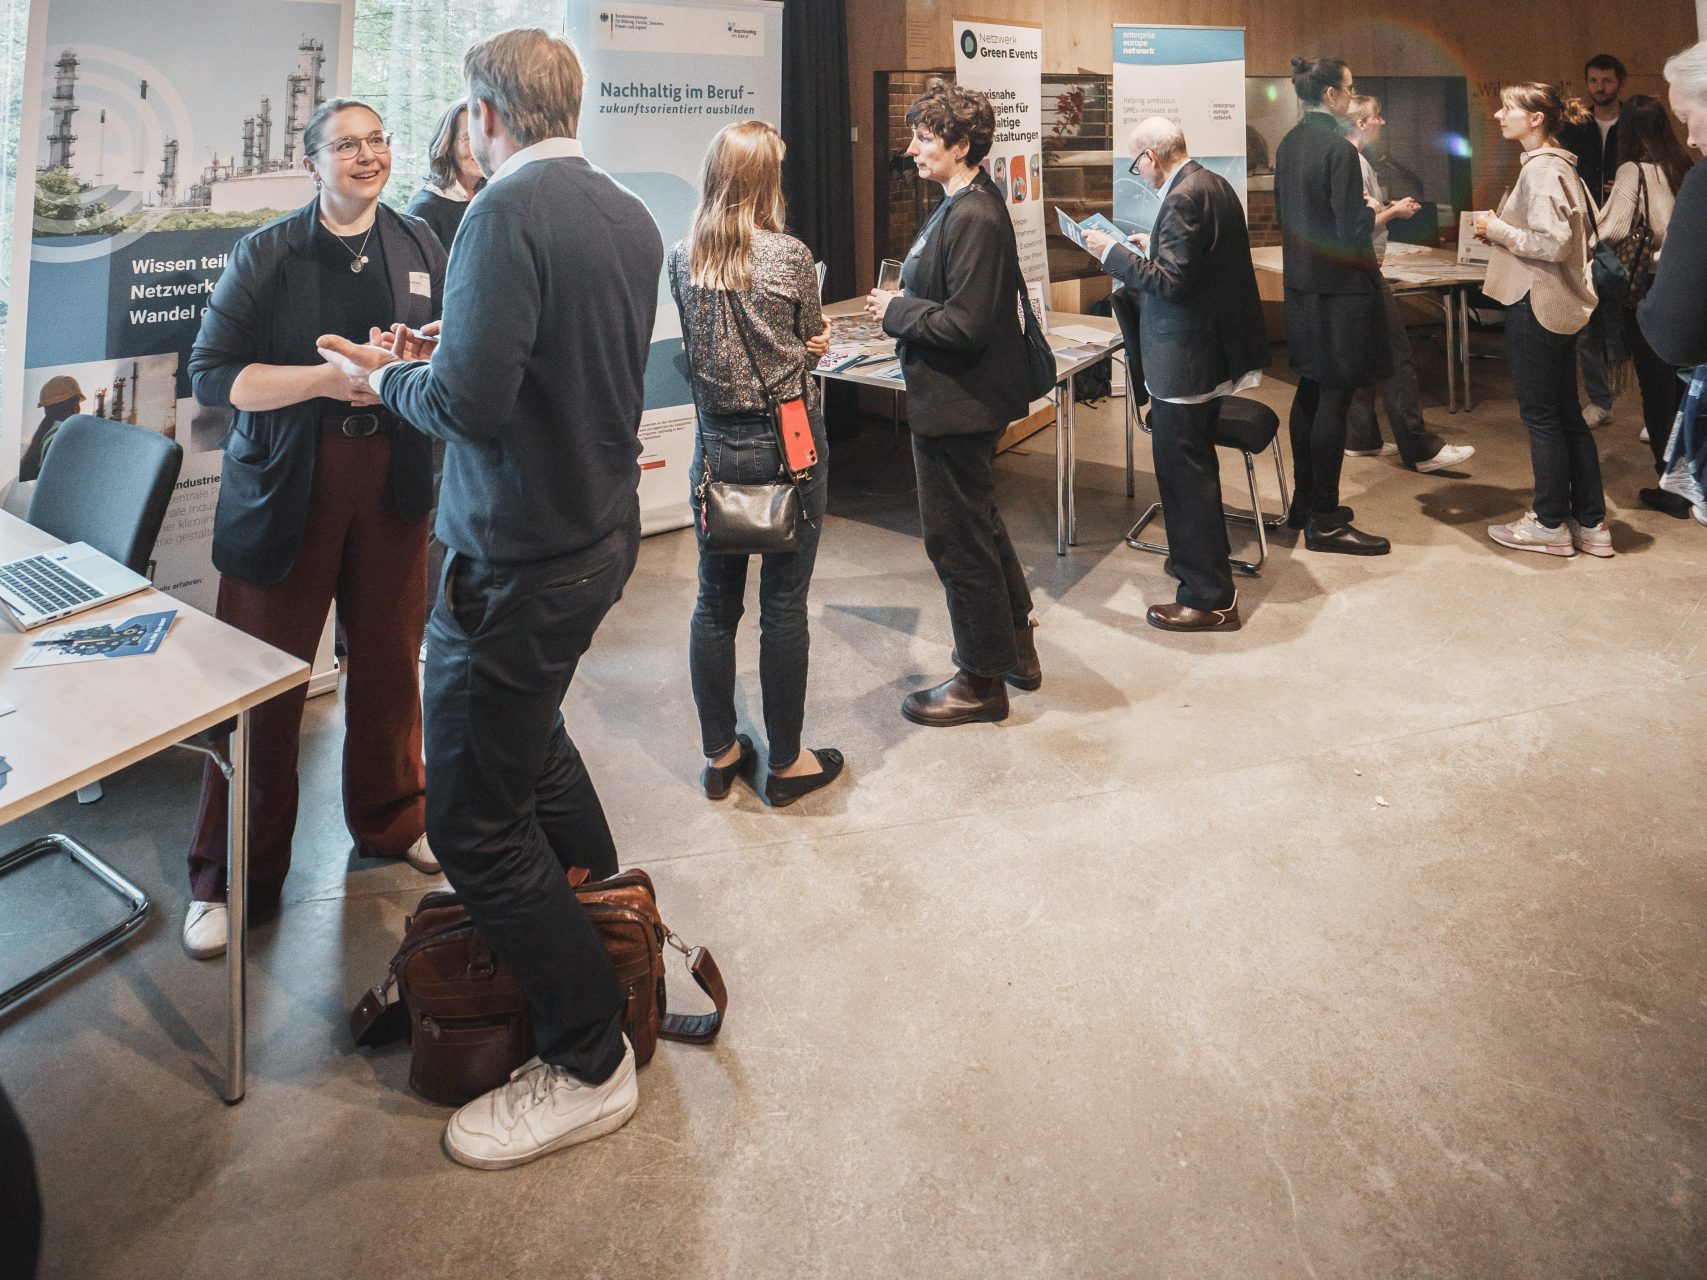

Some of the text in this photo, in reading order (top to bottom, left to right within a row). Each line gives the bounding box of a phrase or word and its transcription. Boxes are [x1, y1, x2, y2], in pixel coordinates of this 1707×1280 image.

[979, 33, 1017, 45] Netzwerk
[980, 47, 1038, 60] Green Events
[1123, 47, 1155, 55] network
[600, 82, 682, 102] Nachhaltig
[686, 84, 703, 98] im
[707, 84, 744, 99] Beruf
[1015, 102, 1029, 113] für
[1123, 97, 1145, 105] Helping
[599, 103, 755, 116] zukunftsorientiert ausbilden
[1123, 106, 1139, 114] SMEs
[995, 117, 1021, 130] altige
[132, 258, 196, 274] Wissen
[130, 278, 214, 300] Netzwerk
[129, 304, 196, 325] Wandel
[175, 474, 222, 490] ndustrie
